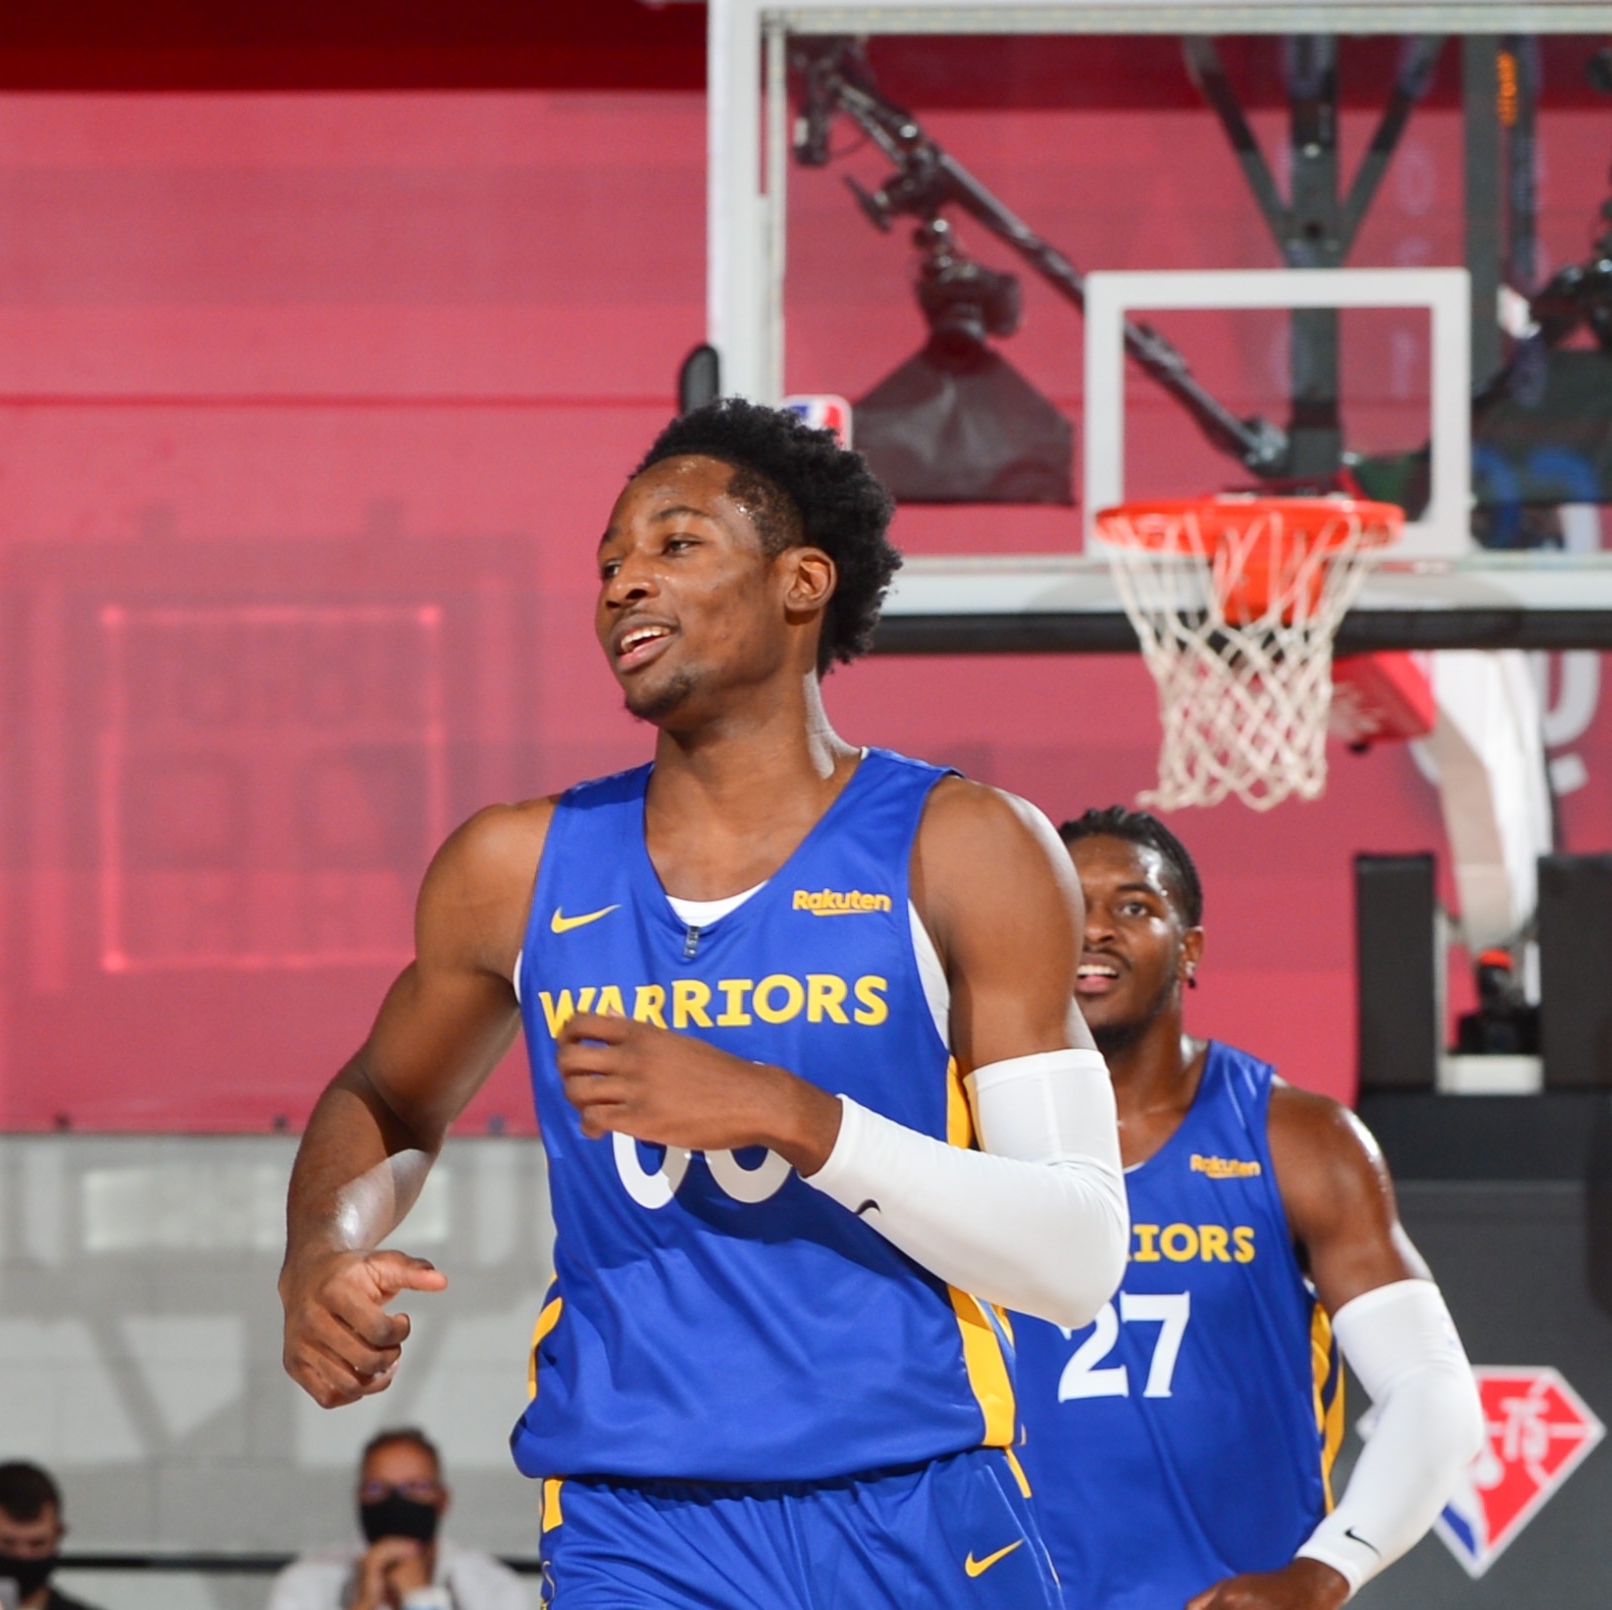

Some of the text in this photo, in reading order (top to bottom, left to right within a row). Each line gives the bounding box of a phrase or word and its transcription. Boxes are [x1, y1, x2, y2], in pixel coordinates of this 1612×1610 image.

[792, 888, 892, 916] Rakuten
[538, 974, 888, 1039] WARRIORS
[1130, 1222, 1256, 1264] IORS
[1058, 1290, 1190, 1403] 27
